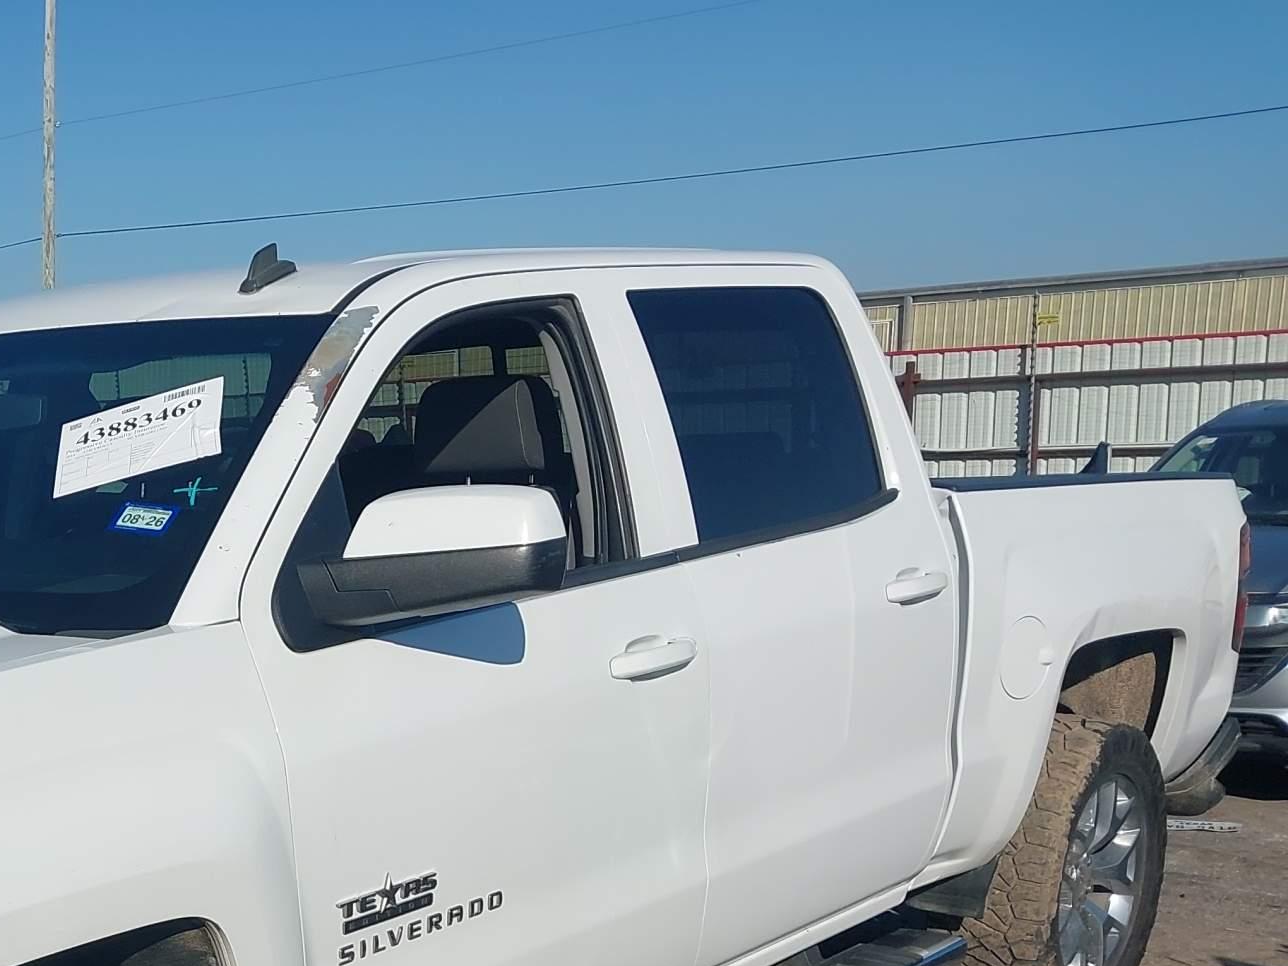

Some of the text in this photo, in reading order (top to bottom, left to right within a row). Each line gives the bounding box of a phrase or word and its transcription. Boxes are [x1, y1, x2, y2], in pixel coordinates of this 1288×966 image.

[75, 398, 203, 446] 43883469
[121, 513, 166, 528] 08 26
[336, 872, 438, 919] TEXAS
[338, 891, 503, 966] SILVERADO
